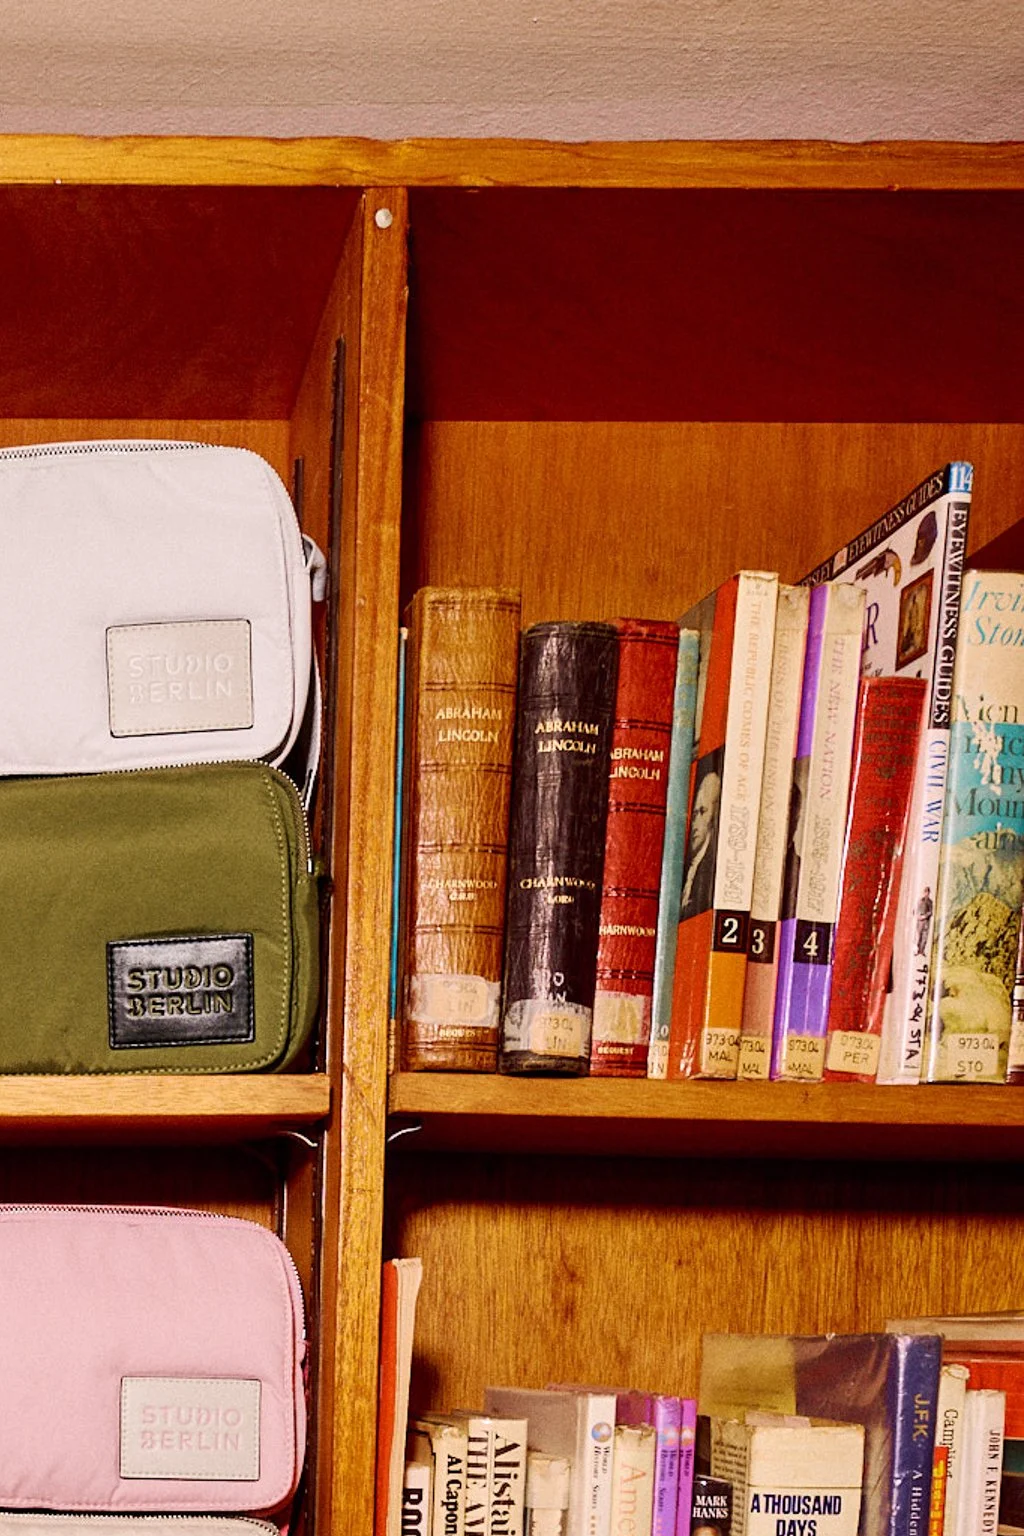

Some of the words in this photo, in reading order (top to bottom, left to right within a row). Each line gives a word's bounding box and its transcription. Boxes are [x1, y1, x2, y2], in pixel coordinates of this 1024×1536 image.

[952, 466, 972, 490] 114
[942, 509, 967, 640] EYEWITNESS
[128, 653, 233, 678] STUDIO
[128, 681, 232, 703] BERLIN
[933, 644, 954, 728] GUIDES
[436, 706, 502, 721] ABRAHAM
[438, 730, 499, 743] LINCOLN
[535, 720, 599, 736] ABRAHAM
[538, 739, 596, 754] LINCOLN
[928, 739, 946, 791] CIVIL
[922, 799, 941, 842] WAR
[721, 917, 738, 943] 2
[752, 929, 765, 953] 3
[803, 931, 818, 956] 4
[127, 964, 234, 990] STUDIO
[127, 992, 232, 1017] BERLIN
[844, 1052, 868, 1064] PER
[958, 1060, 982, 1073] STO
[141, 1406, 242, 1426] STUDIO
[141, 1431, 240, 1451] BERLIN
[447, 1454, 461, 1477] Al
[694, 1494, 727, 1507] MARK
[751, 1494, 761, 1513] A
[764, 1494, 841, 1516] THOUSAND
[692, 1507, 728, 1519] HANKS
